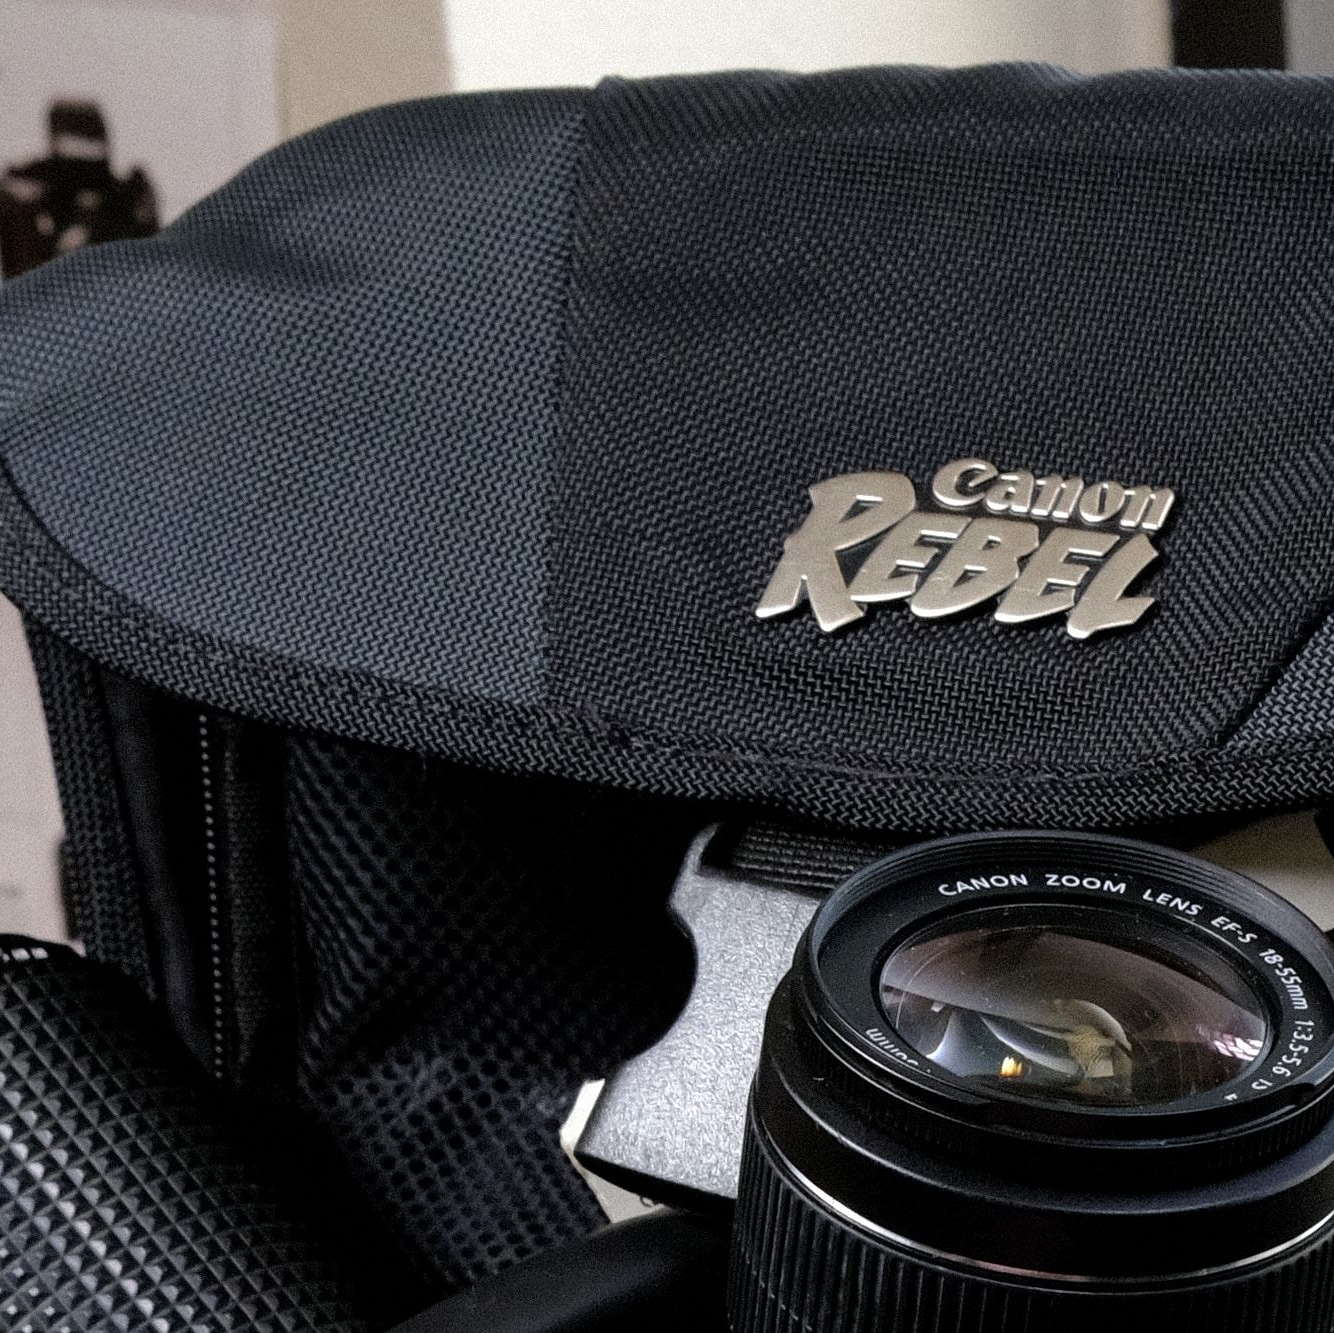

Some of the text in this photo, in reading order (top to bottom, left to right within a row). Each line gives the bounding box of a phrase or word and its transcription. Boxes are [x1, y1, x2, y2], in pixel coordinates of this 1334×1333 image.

[932, 457, 1175, 531] Canon
[756, 470, 1158, 639] REBEL
[937, 873, 1028, 896] CANON
[1044, 873, 1127, 895] ZOOM
[1142, 888, 1204, 916] LENS
[1211, 915, 1258, 944] EF-S
[1259, 948, 1309, 1010] 18-55mm
[1272, 1019, 1315, 1078] 1:3.5-5.6
